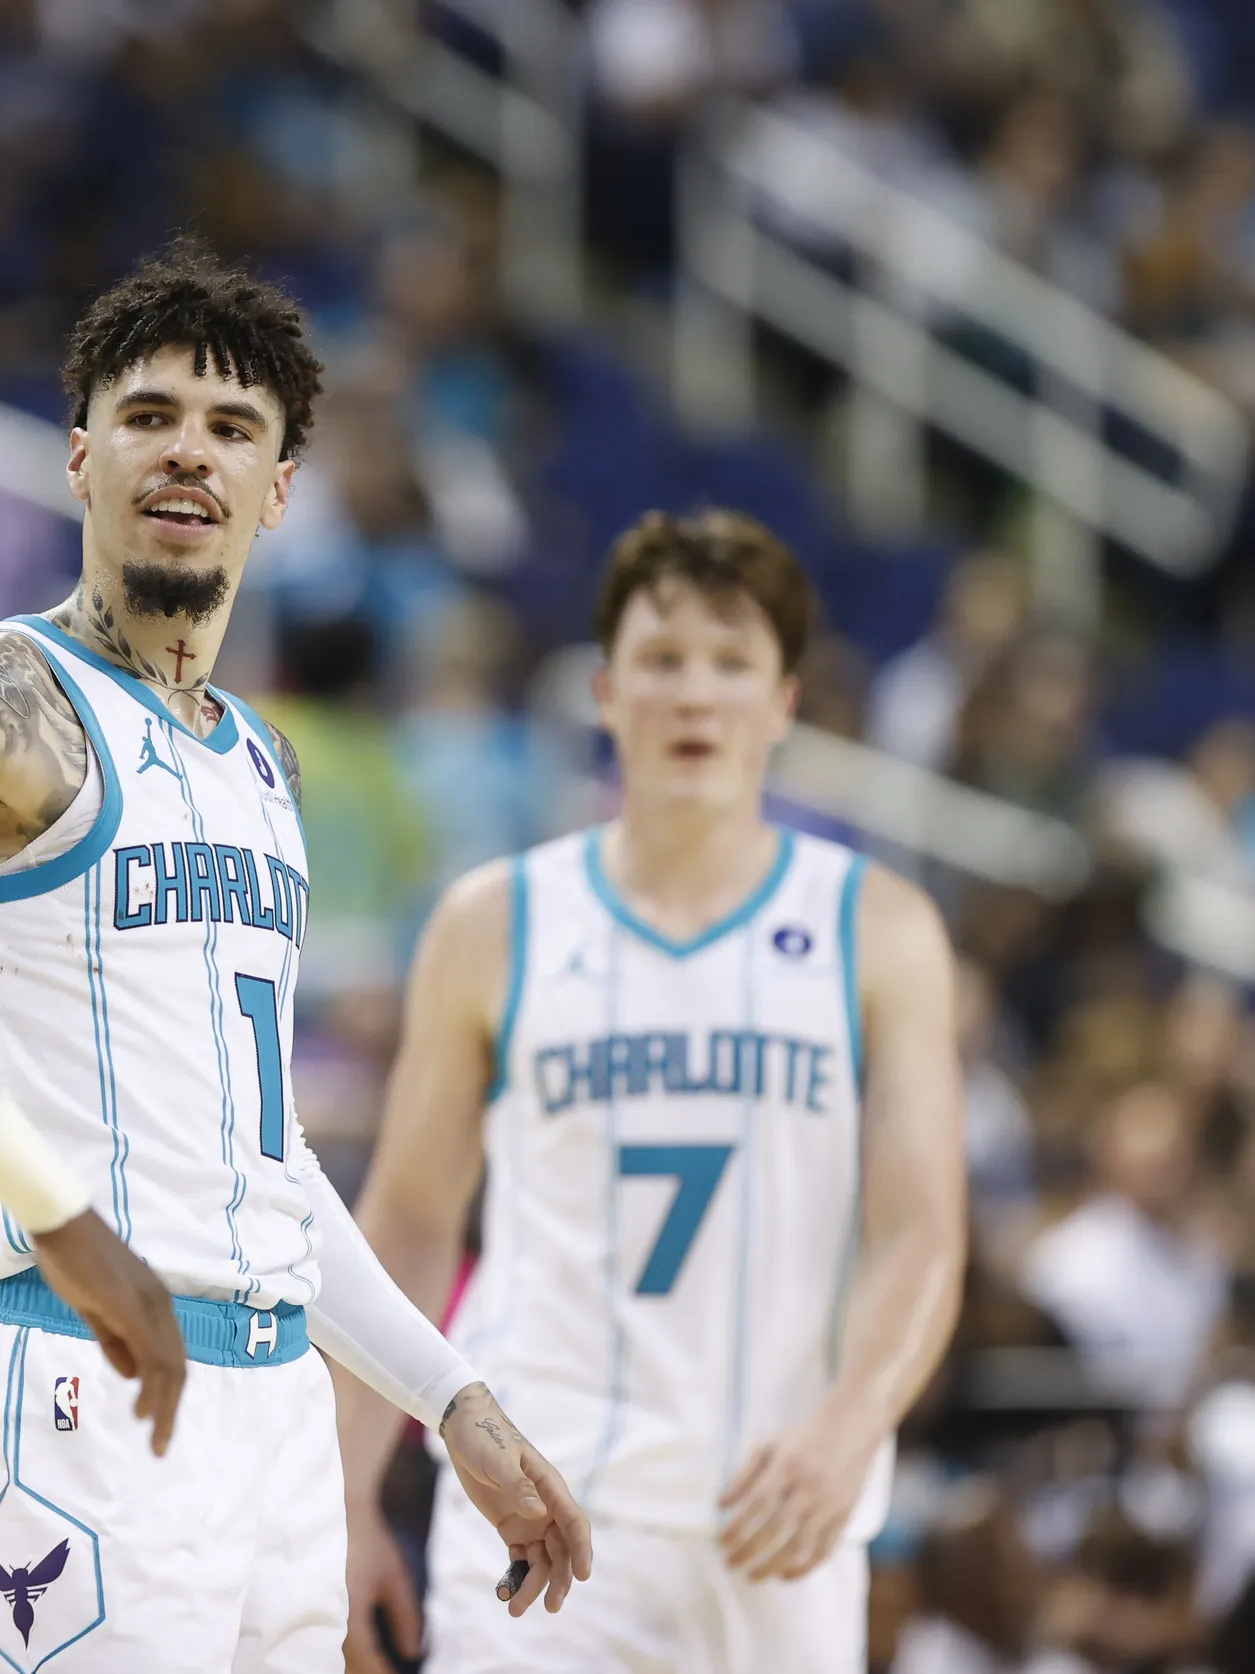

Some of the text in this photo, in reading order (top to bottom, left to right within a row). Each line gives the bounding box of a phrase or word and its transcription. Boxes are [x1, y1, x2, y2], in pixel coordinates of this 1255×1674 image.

[234, 971, 284, 1164] 1
[533, 1028, 834, 1116] CHARLOTTE
[617, 1143, 736, 1298] 7
[57, 1418, 71, 1429] NBA
